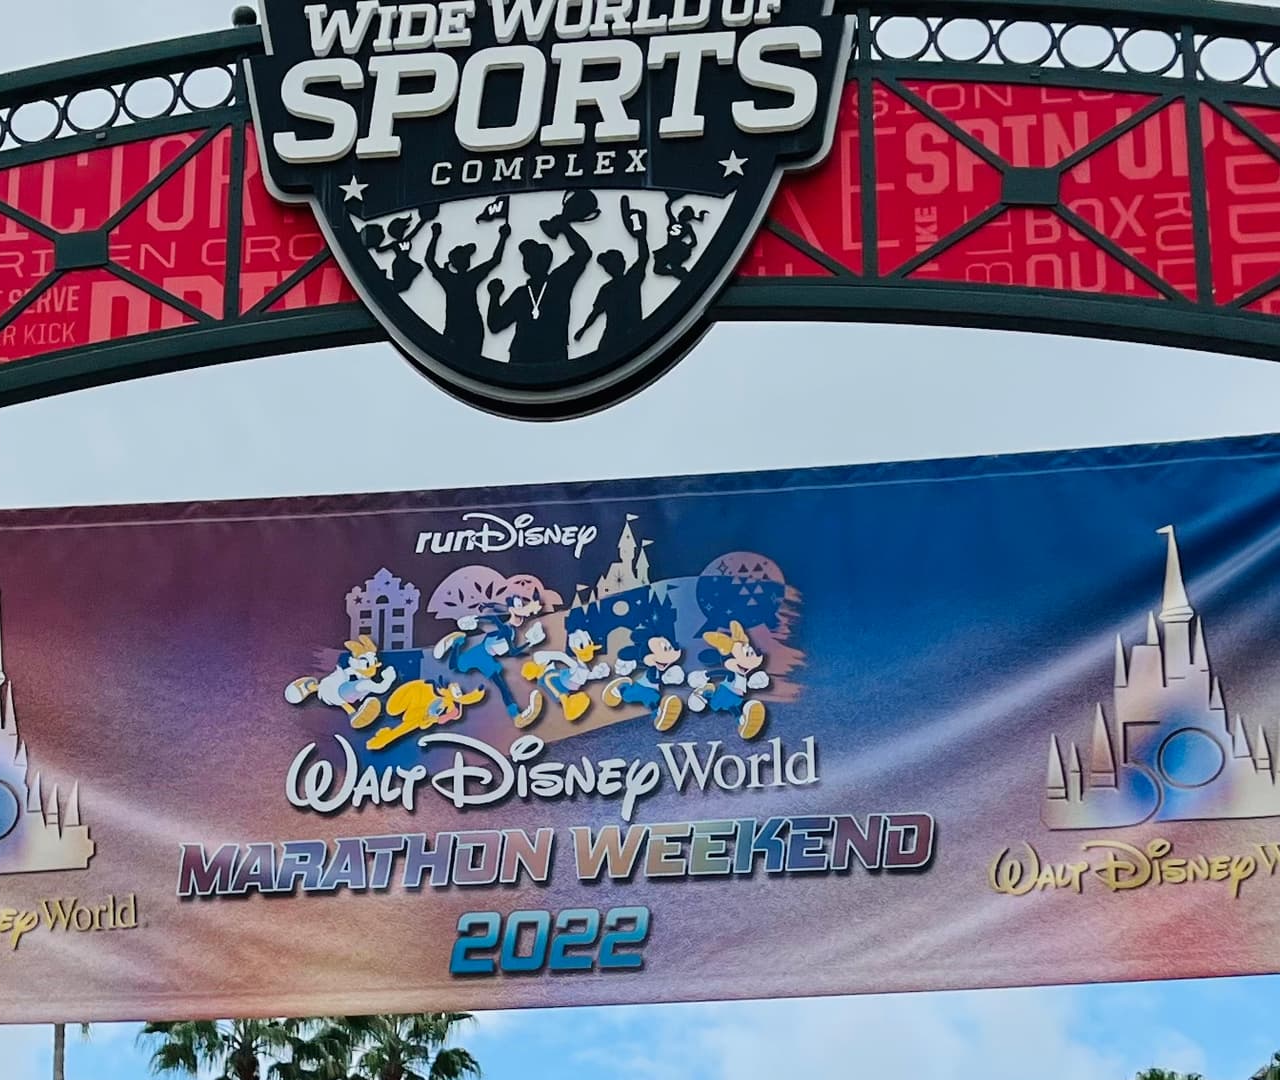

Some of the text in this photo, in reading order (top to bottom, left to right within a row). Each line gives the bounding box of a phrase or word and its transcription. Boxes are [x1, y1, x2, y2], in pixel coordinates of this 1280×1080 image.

[304, 0, 475, 57] WIDE
[488, 0, 712, 43] WORLD
[273, 25, 822, 163] SPORTS
[431, 148, 648, 186] COMPLEX
[23, 321, 76, 345] KICK
[414, 512, 598, 558] runDisney
[285, 732, 820, 822] Walt Disney World
[177, 811, 937, 899] MARATHON WEEKEND
[987, 839, 1090, 897] Walt
[1082, 838, 1259, 900] Disney
[39, 893, 139, 934] World
[448, 905, 651, 979] 2022
